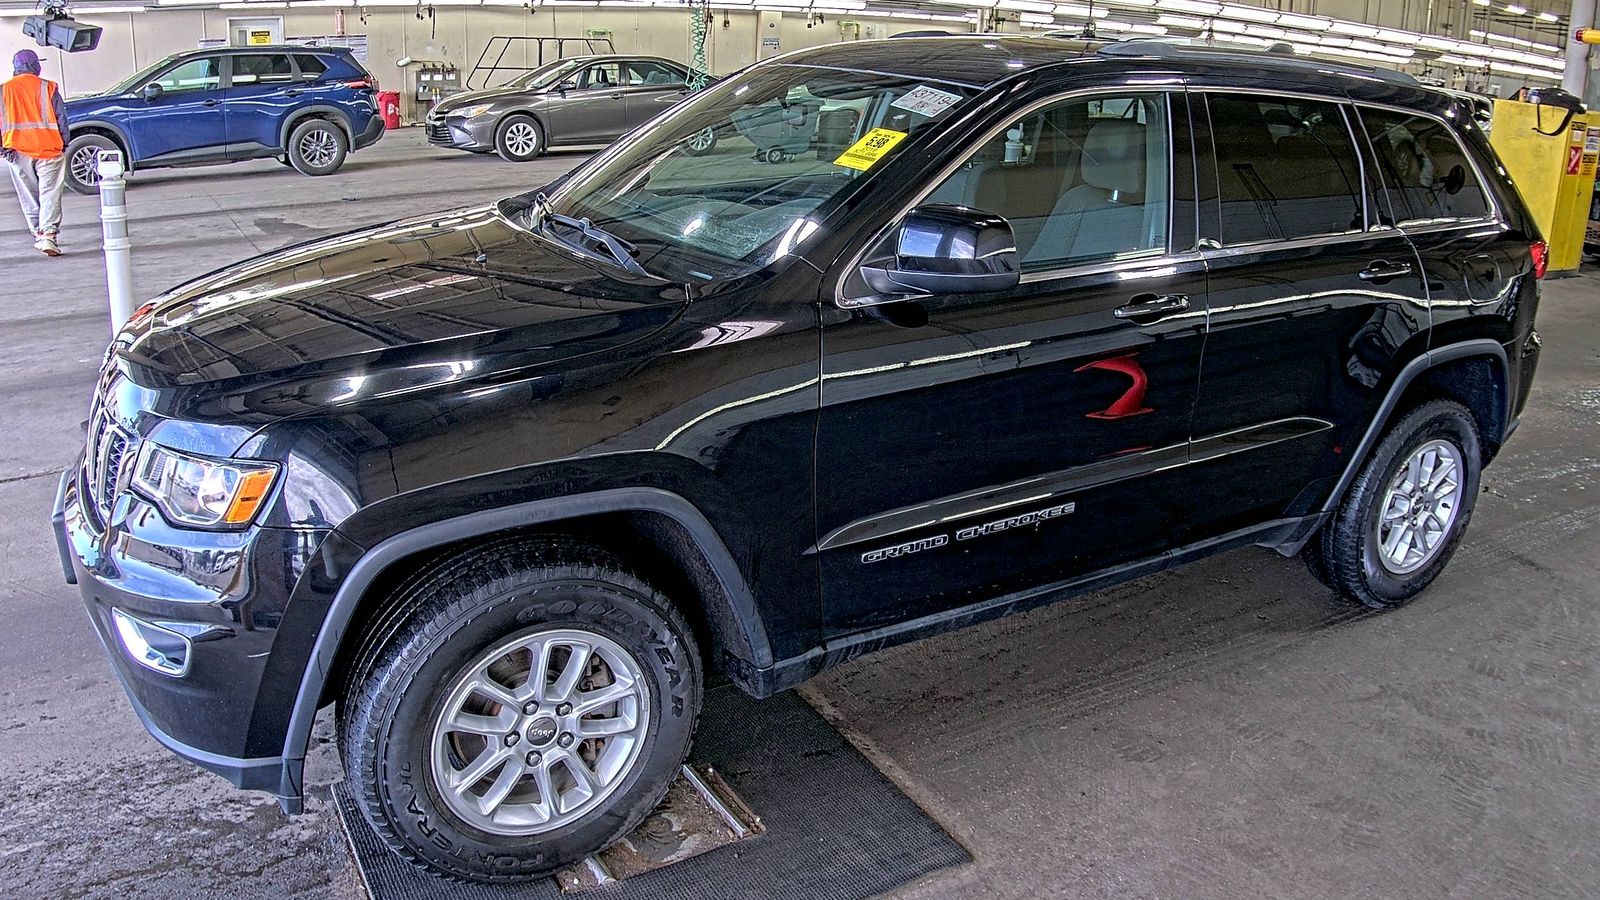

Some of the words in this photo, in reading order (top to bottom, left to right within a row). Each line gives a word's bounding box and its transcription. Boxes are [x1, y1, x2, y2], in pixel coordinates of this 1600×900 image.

[861, 534, 949, 564] GRAND
[956, 502, 1076, 541] CHEROKEE
[516, 599, 684, 719] GOODYEAR
